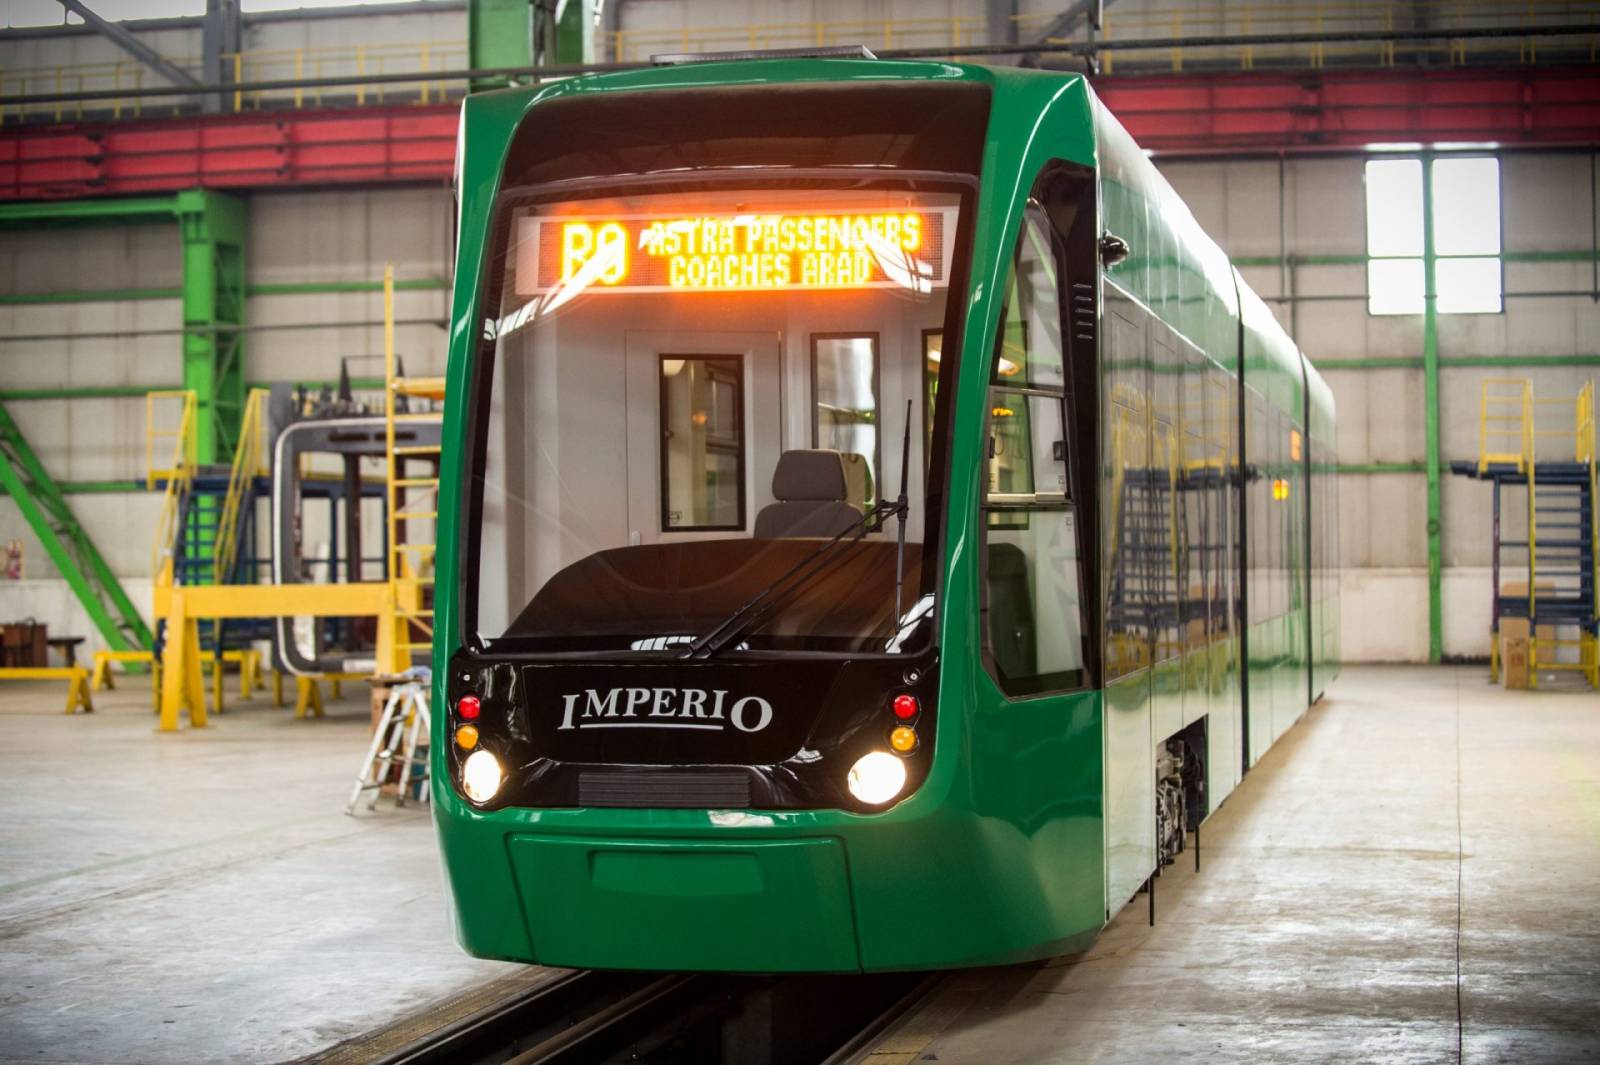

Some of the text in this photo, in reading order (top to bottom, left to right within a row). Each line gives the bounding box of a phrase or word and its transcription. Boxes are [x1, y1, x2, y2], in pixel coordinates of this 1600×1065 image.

[648, 217, 736, 256] ASTRA
[669, 250, 872, 289] COACHES ARAD
